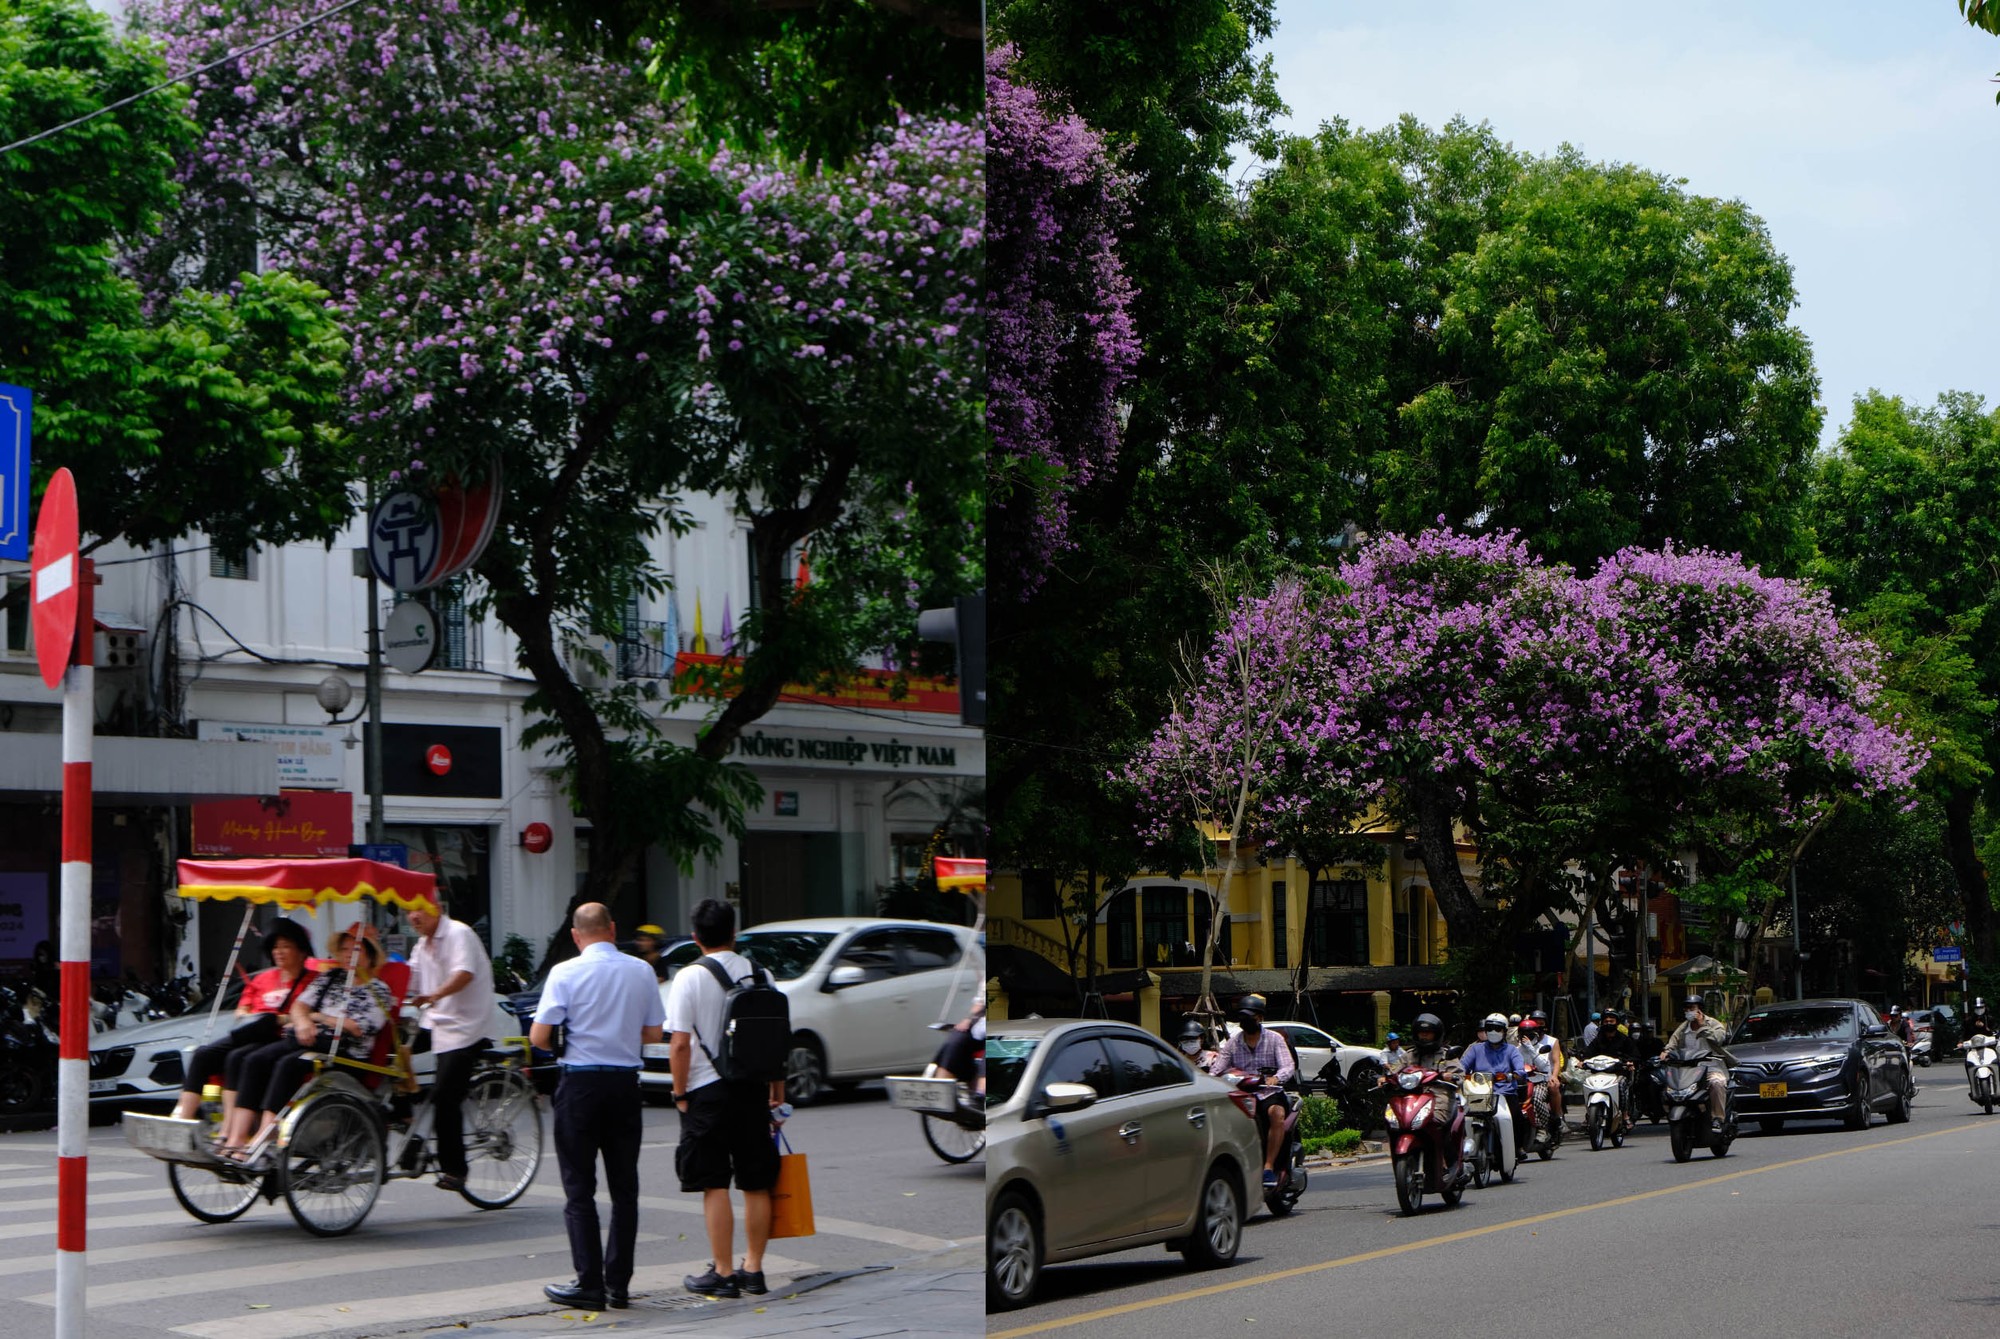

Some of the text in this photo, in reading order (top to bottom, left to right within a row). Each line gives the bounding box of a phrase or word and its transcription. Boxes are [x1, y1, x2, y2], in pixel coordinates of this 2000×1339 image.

[740, 731, 793, 758] NÔNG
[797, 736, 868, 766] NGHIỆP
[870, 738, 913, 767] VIỆT
[916, 746, 956, 766] NAM
